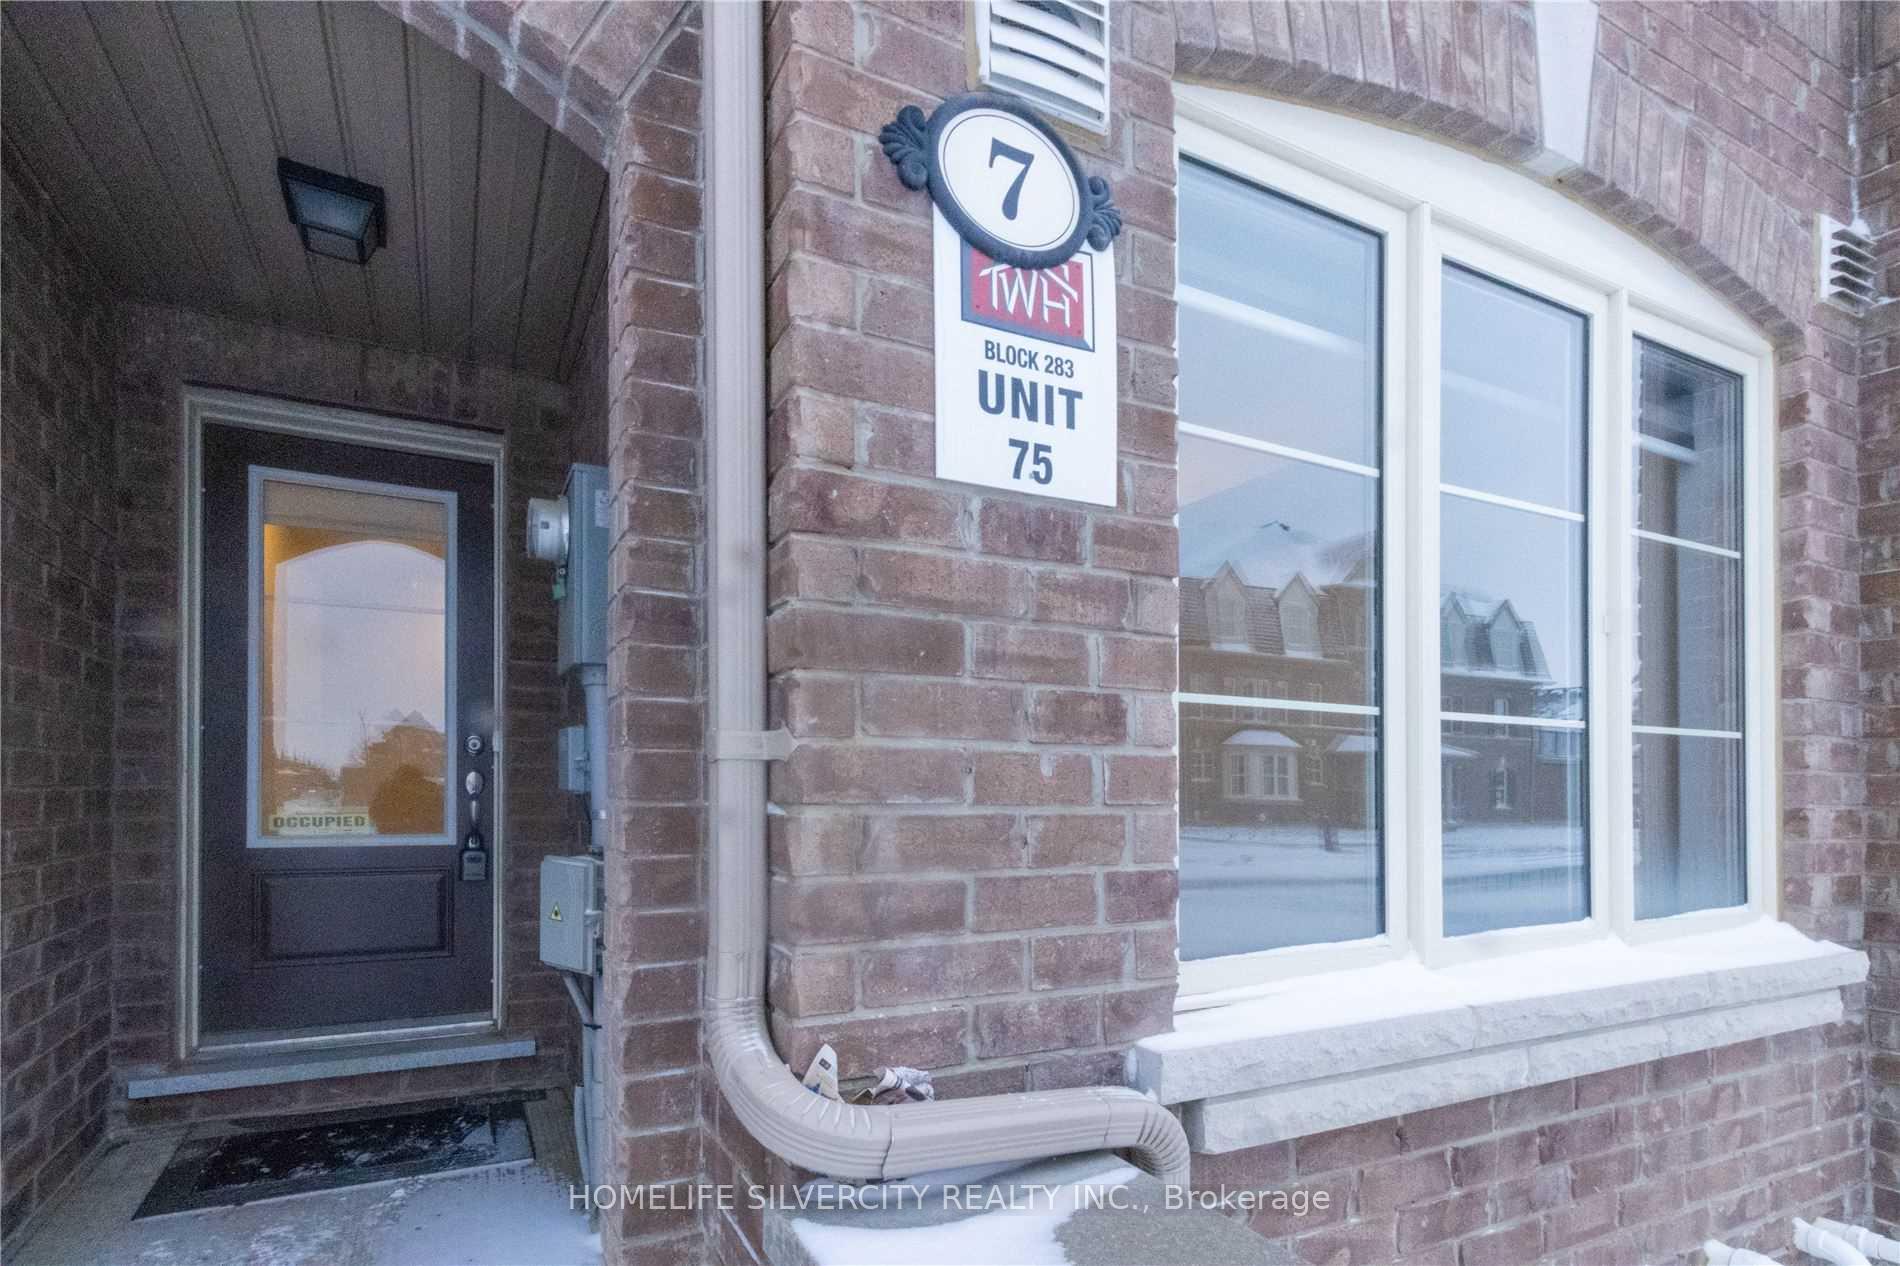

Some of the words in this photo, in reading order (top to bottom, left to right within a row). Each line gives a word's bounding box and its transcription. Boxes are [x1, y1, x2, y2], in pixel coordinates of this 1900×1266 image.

[988, 136, 1035, 221] 7
[984, 340, 1039, 371] BLOCK
[1044, 354, 1074, 378] 283
[978, 369, 1083, 430] UNIT
[1008, 438, 1053, 485] 75
[273, 816, 365, 828] OCCUPIED
